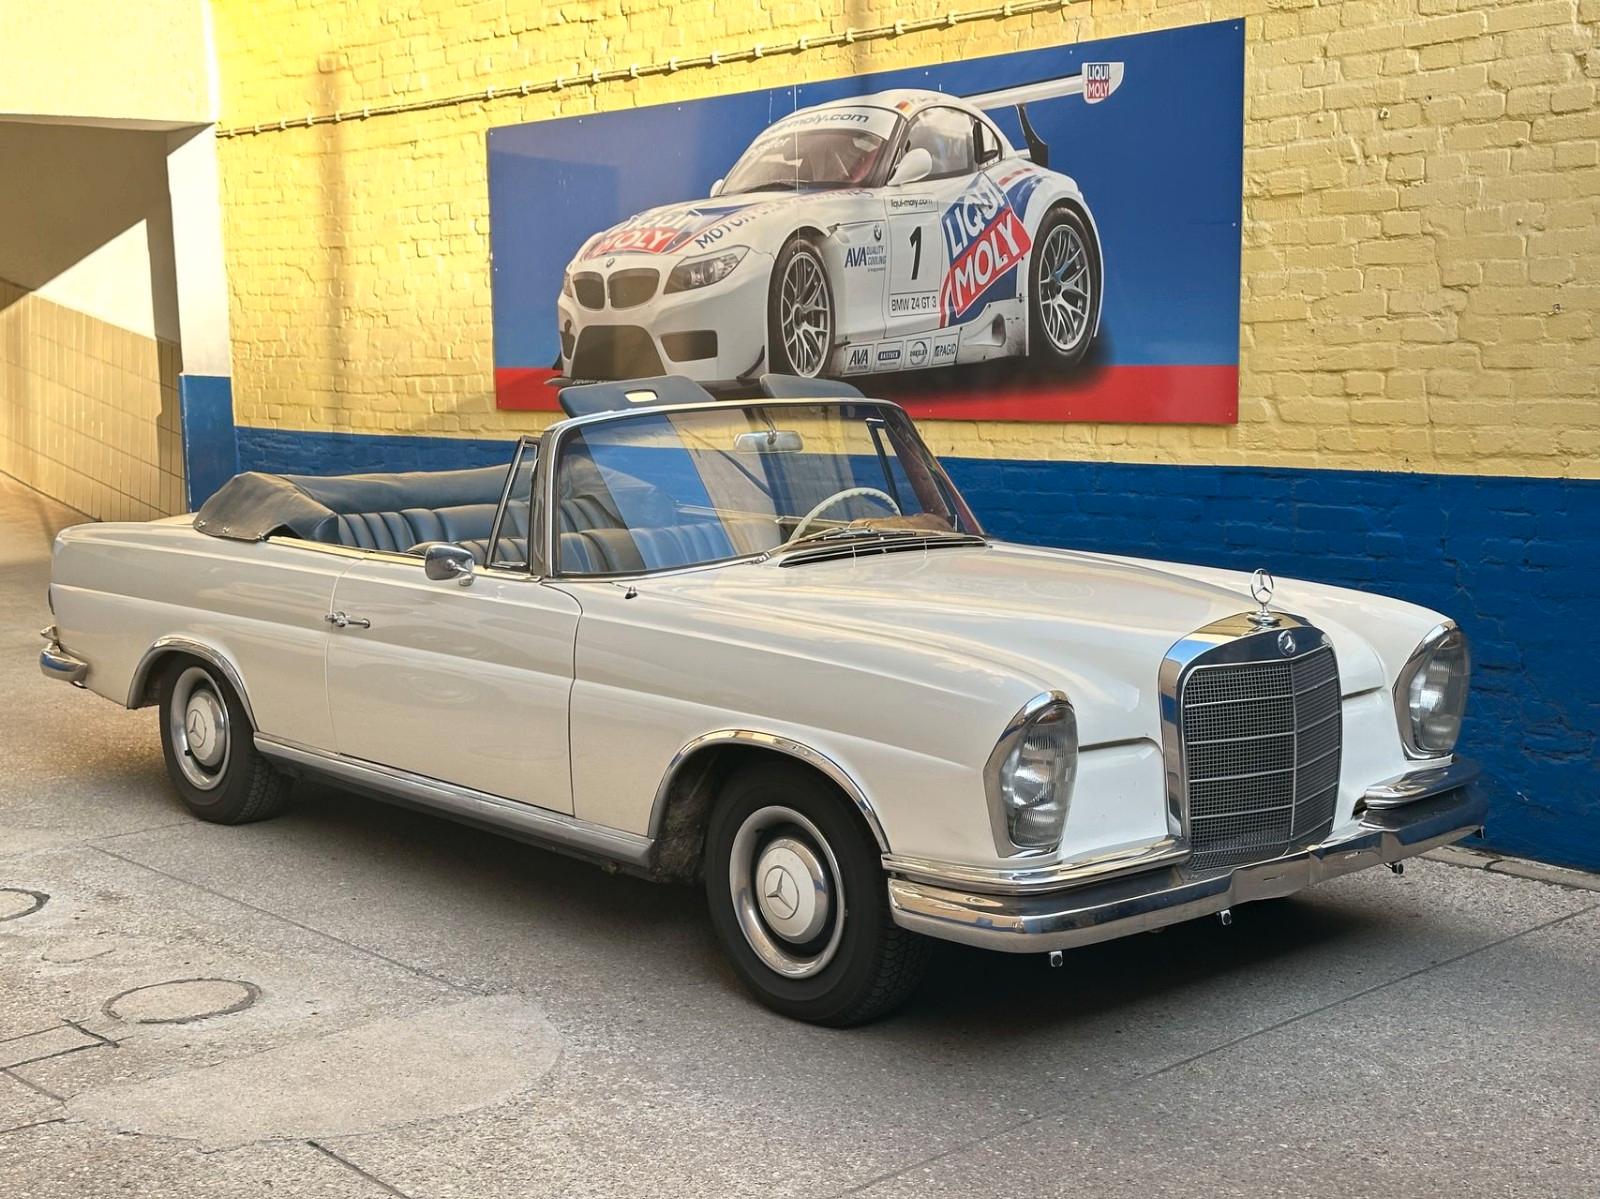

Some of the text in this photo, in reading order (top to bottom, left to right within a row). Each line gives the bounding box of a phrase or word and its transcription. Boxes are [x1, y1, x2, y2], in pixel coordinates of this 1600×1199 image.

[1088, 65, 1109, 80] LIQUI
[1088, 82, 1109, 97] MOLY
[946, 183, 1005, 259] LIQUI
[844, 247, 867, 268] AVA
[909, 226, 922, 280] 1
[954, 213, 1020, 308] MOLY
[891, 298, 909, 311] BMW
[911, 297, 920, 309] Z4
[849, 349, 868, 365] AVA
